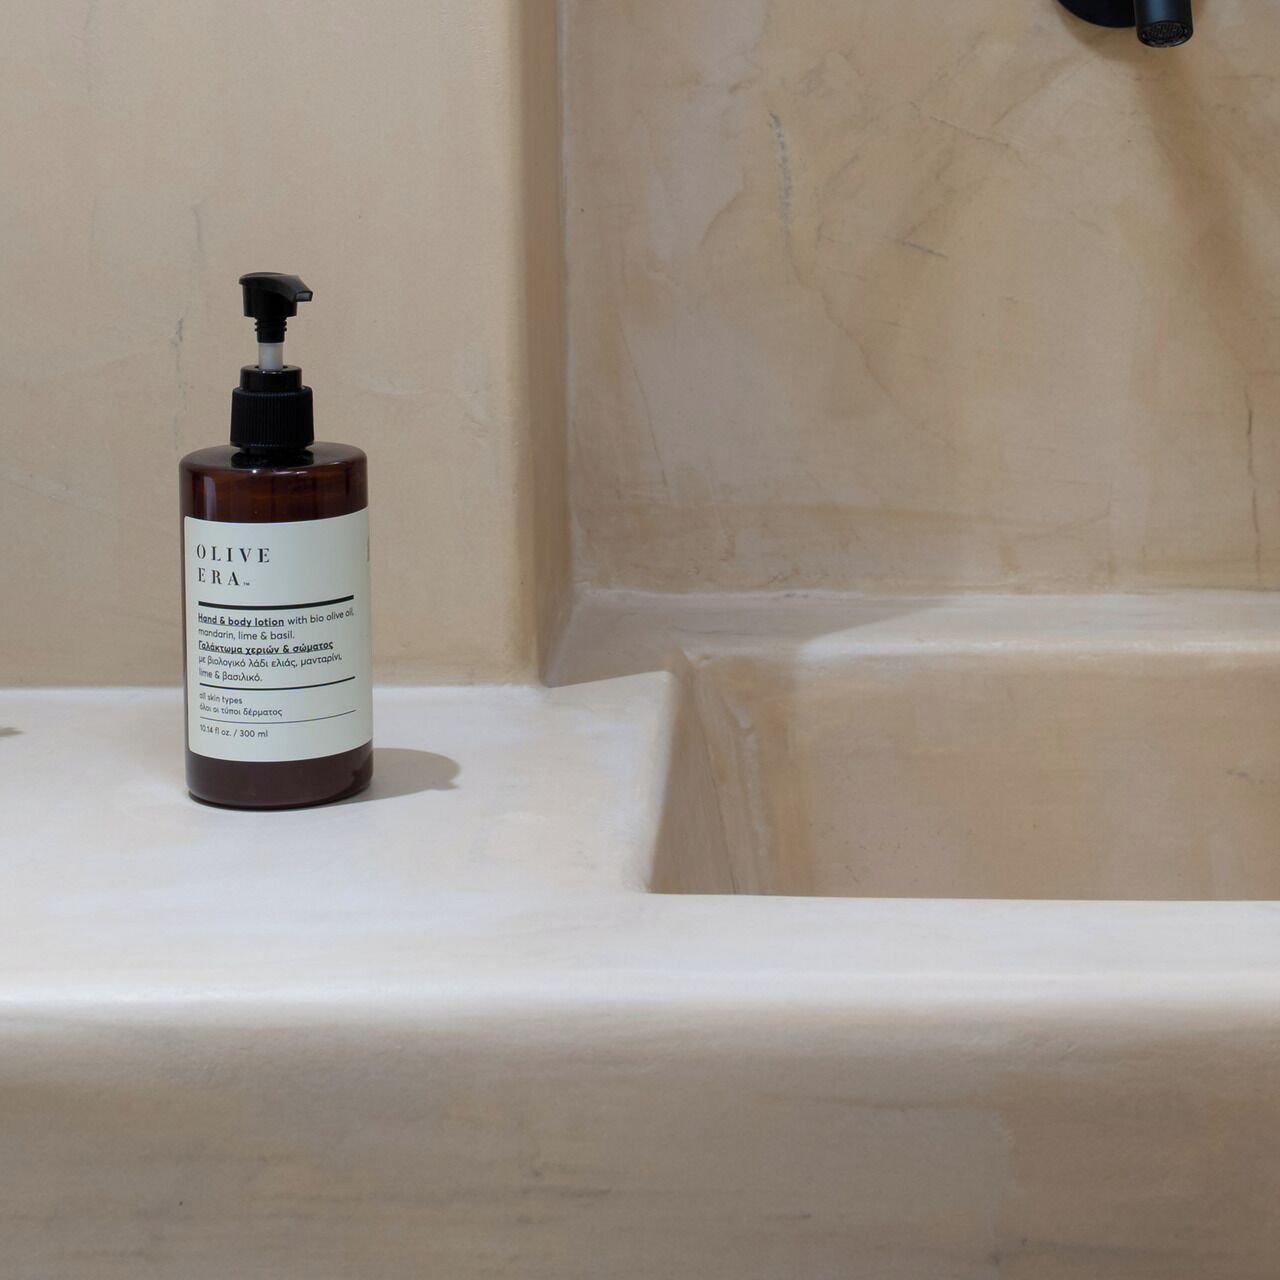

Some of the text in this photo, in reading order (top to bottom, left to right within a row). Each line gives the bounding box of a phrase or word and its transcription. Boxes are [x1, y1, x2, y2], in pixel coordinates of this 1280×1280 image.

[197, 544, 270, 562] OLIVE
[198, 613, 217, 624] Hand
[228, 617, 251, 627] body
[255, 618, 284, 626] lotion
[288, 616, 307, 625] with
[310, 614, 324, 623] bio
[327, 611, 343, 620] olive
[199, 628, 295, 640] mandarin, lime & basil.
[199, 640, 333, 655] Γαλάκτωμα χεριών & σώματος
[199, 656, 206, 664] με
[208, 656, 246, 667] βιολογικό
[248, 659, 268, 667] λάδι
[271, 658, 297, 667] ελιάς,
[199, 669, 262, 682] lime & βασιλικό.
[208, 694, 220, 702] skin
[222, 697, 242, 705] types
[221, 707, 240, 715] τύποι
[243, 708, 282, 717] δέρματος
[221, 729, 231, 737] oz.
[240, 729, 255, 737] 300
